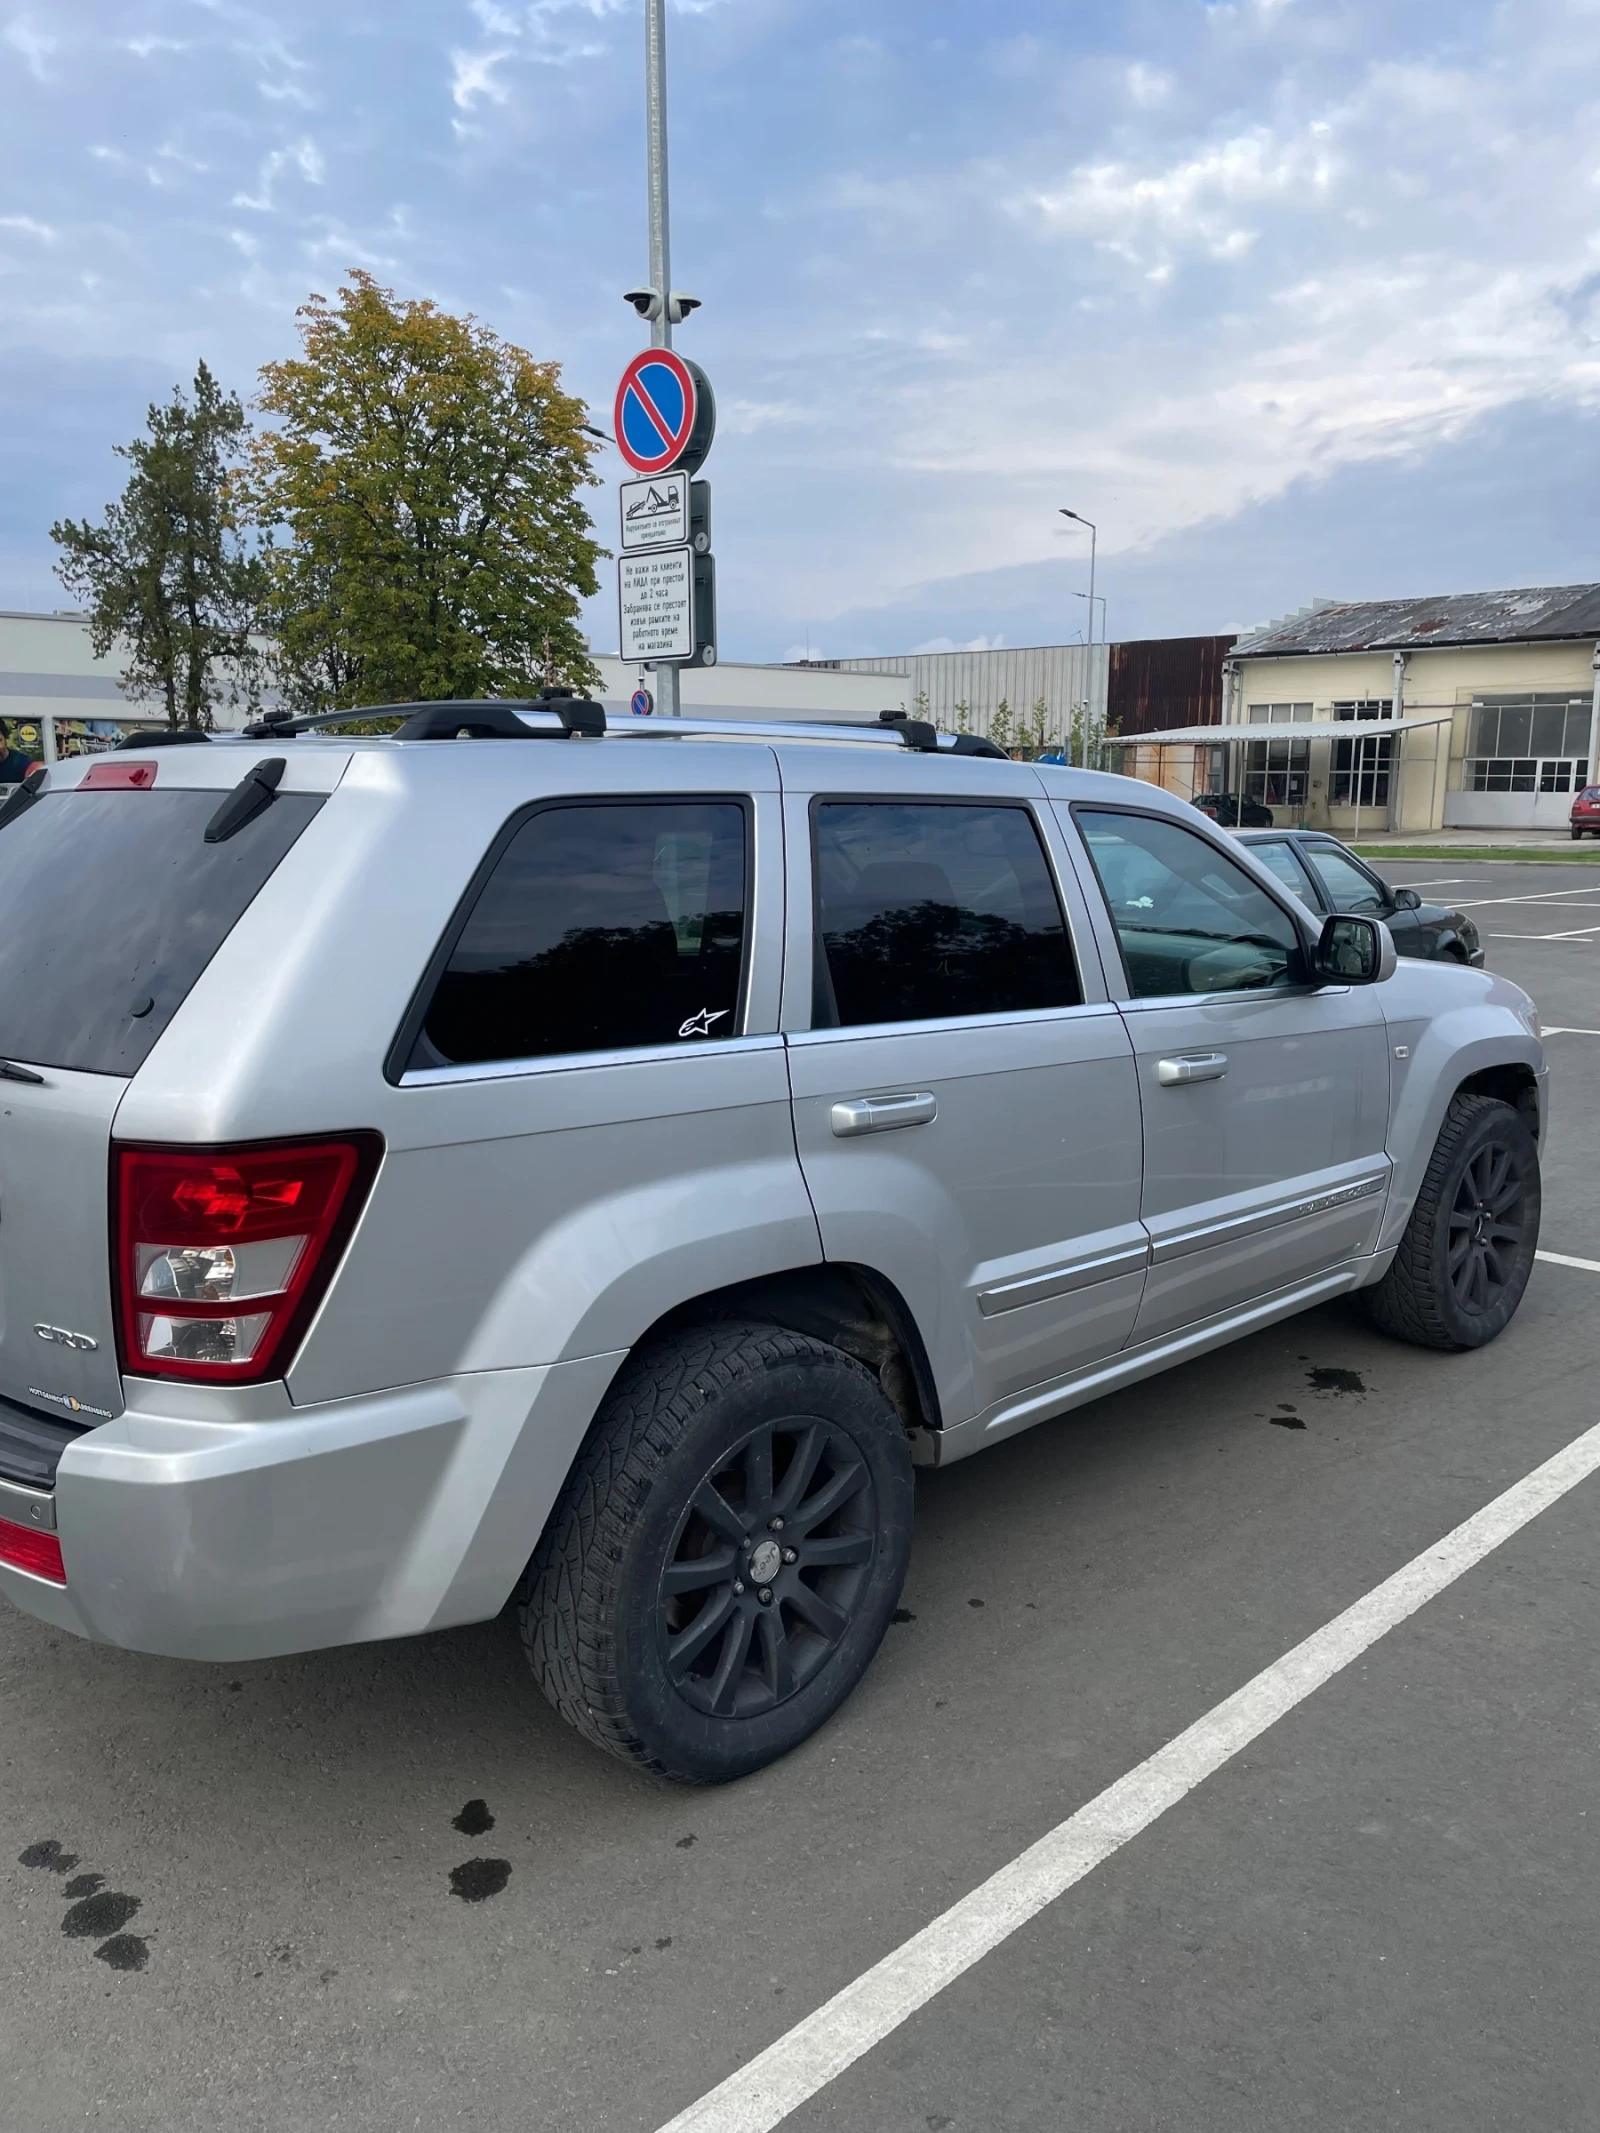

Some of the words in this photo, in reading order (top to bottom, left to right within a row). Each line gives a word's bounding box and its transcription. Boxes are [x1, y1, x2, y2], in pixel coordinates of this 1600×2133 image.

[626, 566, 633, 575] Не
[635, 566, 649, 574] важи
[652, 564, 658, 572] за
[660, 561, 682, 570] клиенти
[624, 580, 631, 588] на
[650, 577, 660, 587] при
[662, 573, 684, 586] престой
[640, 592, 647, 600] до
[650, 589, 653, 598] 2
[656, 589, 668, 597] часа
[623, 604, 651, 615] Забранява
[662, 600, 686, 611] престоят
[630, 617, 646, 626] извън
[648, 615, 671, 626] рамките
[673, 614, 680, 622] на
[633, 628, 659, 641] работното
[662, 627, 678, 638] време
[638, 642, 645, 650] на
[647, 640, 672, 650] магазина
[33, 1323, 98, 1350] CRD
